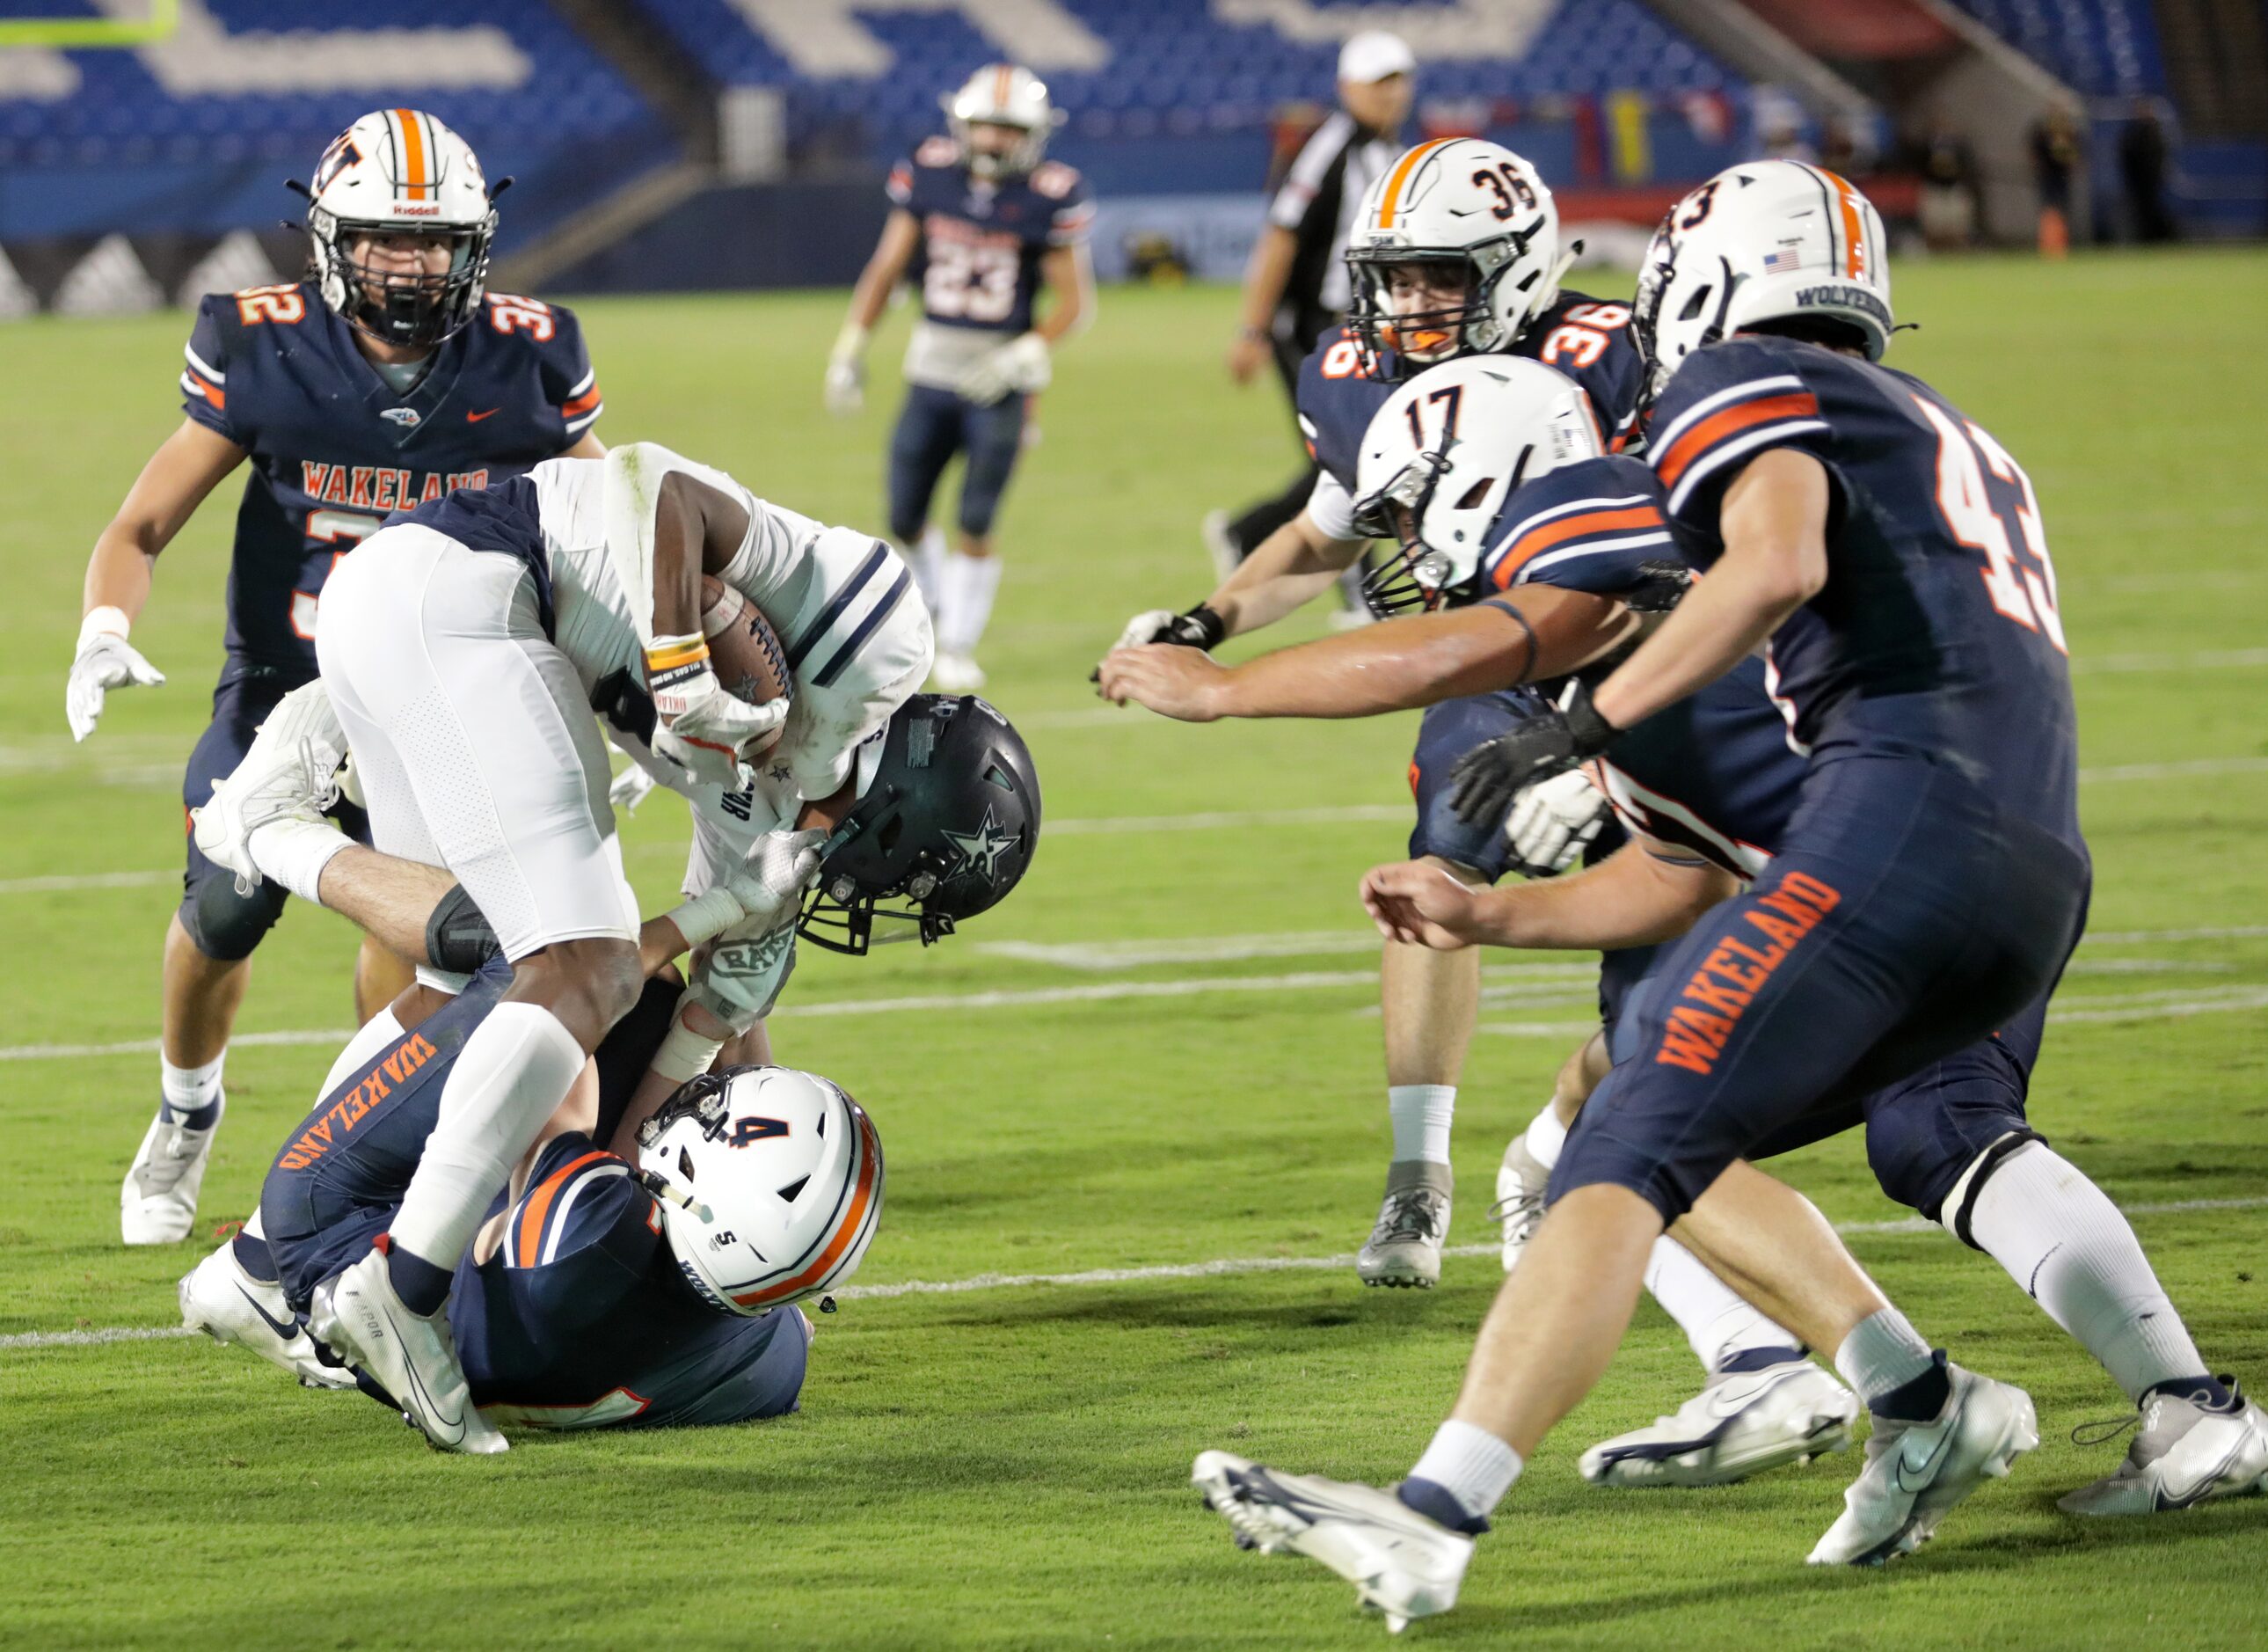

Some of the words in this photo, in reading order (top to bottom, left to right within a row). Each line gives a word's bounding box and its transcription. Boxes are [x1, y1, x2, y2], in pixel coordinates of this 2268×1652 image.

[394, 205, 440, 216] Riddell
[1472, 162, 1537, 222] 36
[923, 241, 1019, 323] 23
[1540, 303, 1633, 369] 36
[1404, 384, 1464, 450] 17
[301, 459, 489, 511] WAKELAND
[1913, 393, 2069, 656] 43
[721, 781, 755, 822] TAR
[1655, 871, 1841, 1075] WAKELAND
[278, 1032, 438, 1170] WAKELAND
[729, 1115, 791, 1149] 4
